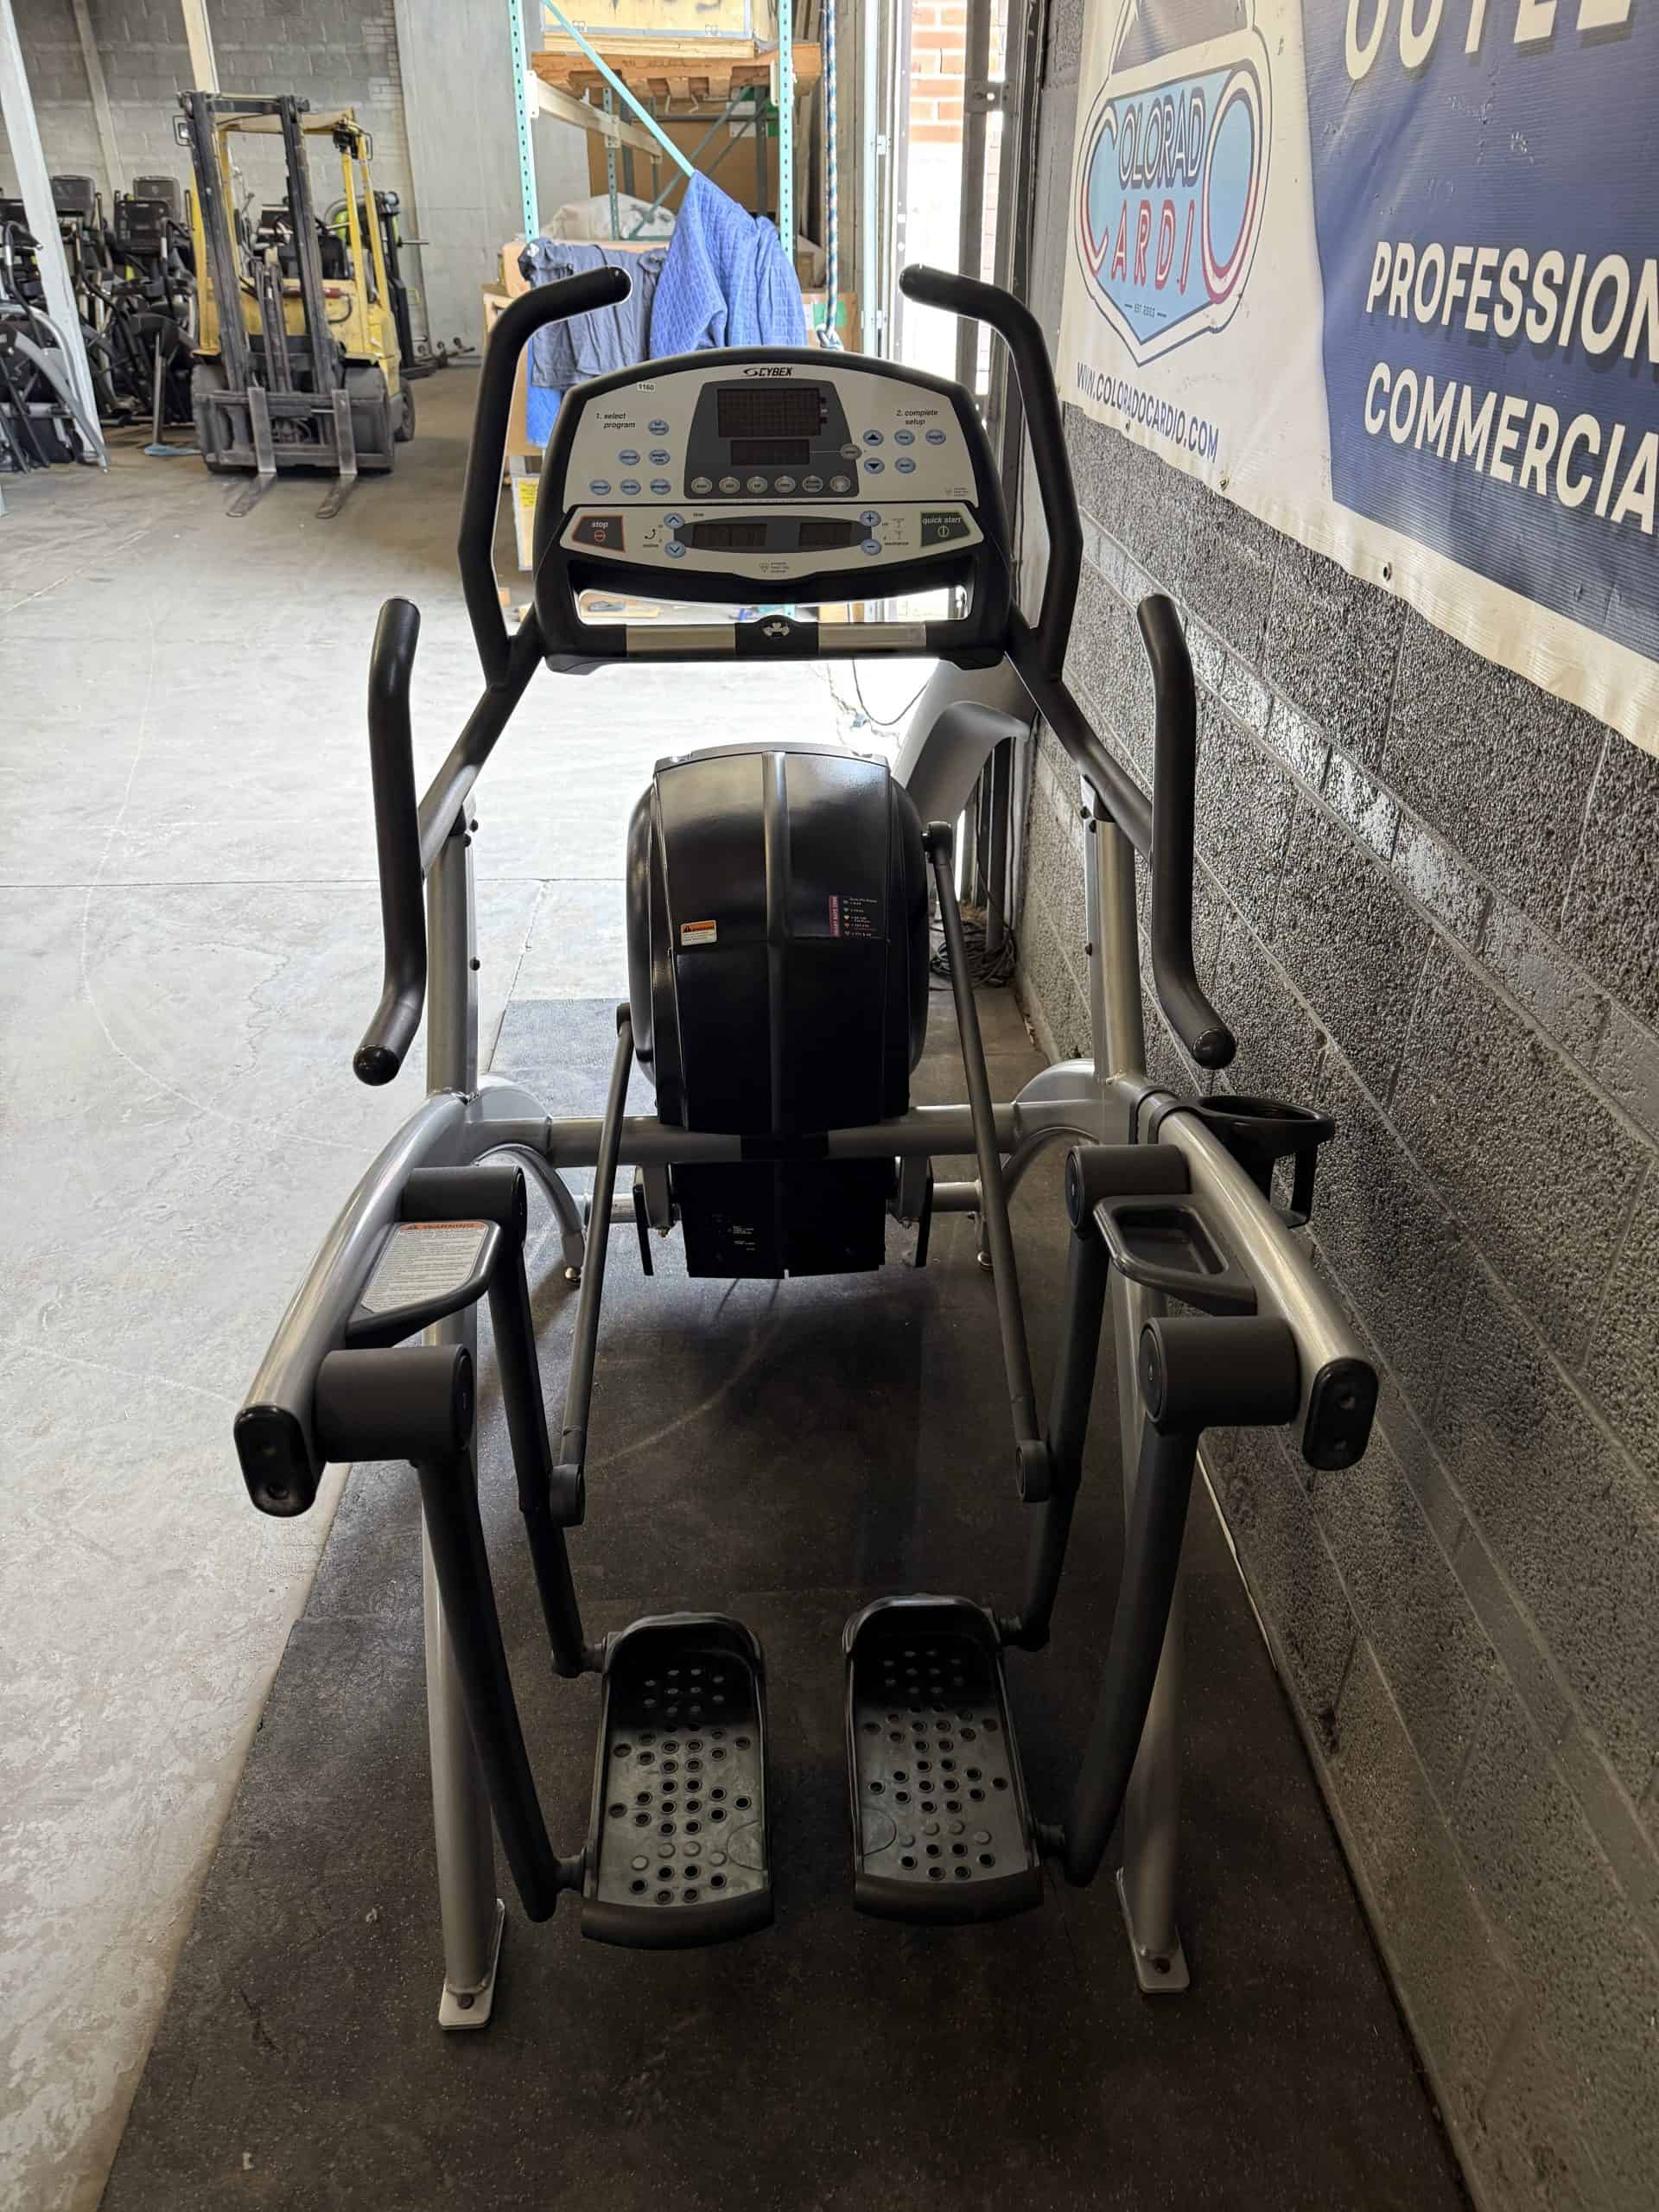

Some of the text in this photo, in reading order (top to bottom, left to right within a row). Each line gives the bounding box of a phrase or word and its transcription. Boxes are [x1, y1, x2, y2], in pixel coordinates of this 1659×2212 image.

[1365, 241, 1659, 364] PROFESSION
[760, 367, 792, 376] CYBEX
[905, 408, 938, 416] complete
[603, 421, 636, 429] program
[905, 417, 926, 426] setup
[1364, 362, 1659, 535] COMMERCIA
[591, 520, 609, 529] stop
[923, 517, 943, 525] quick
